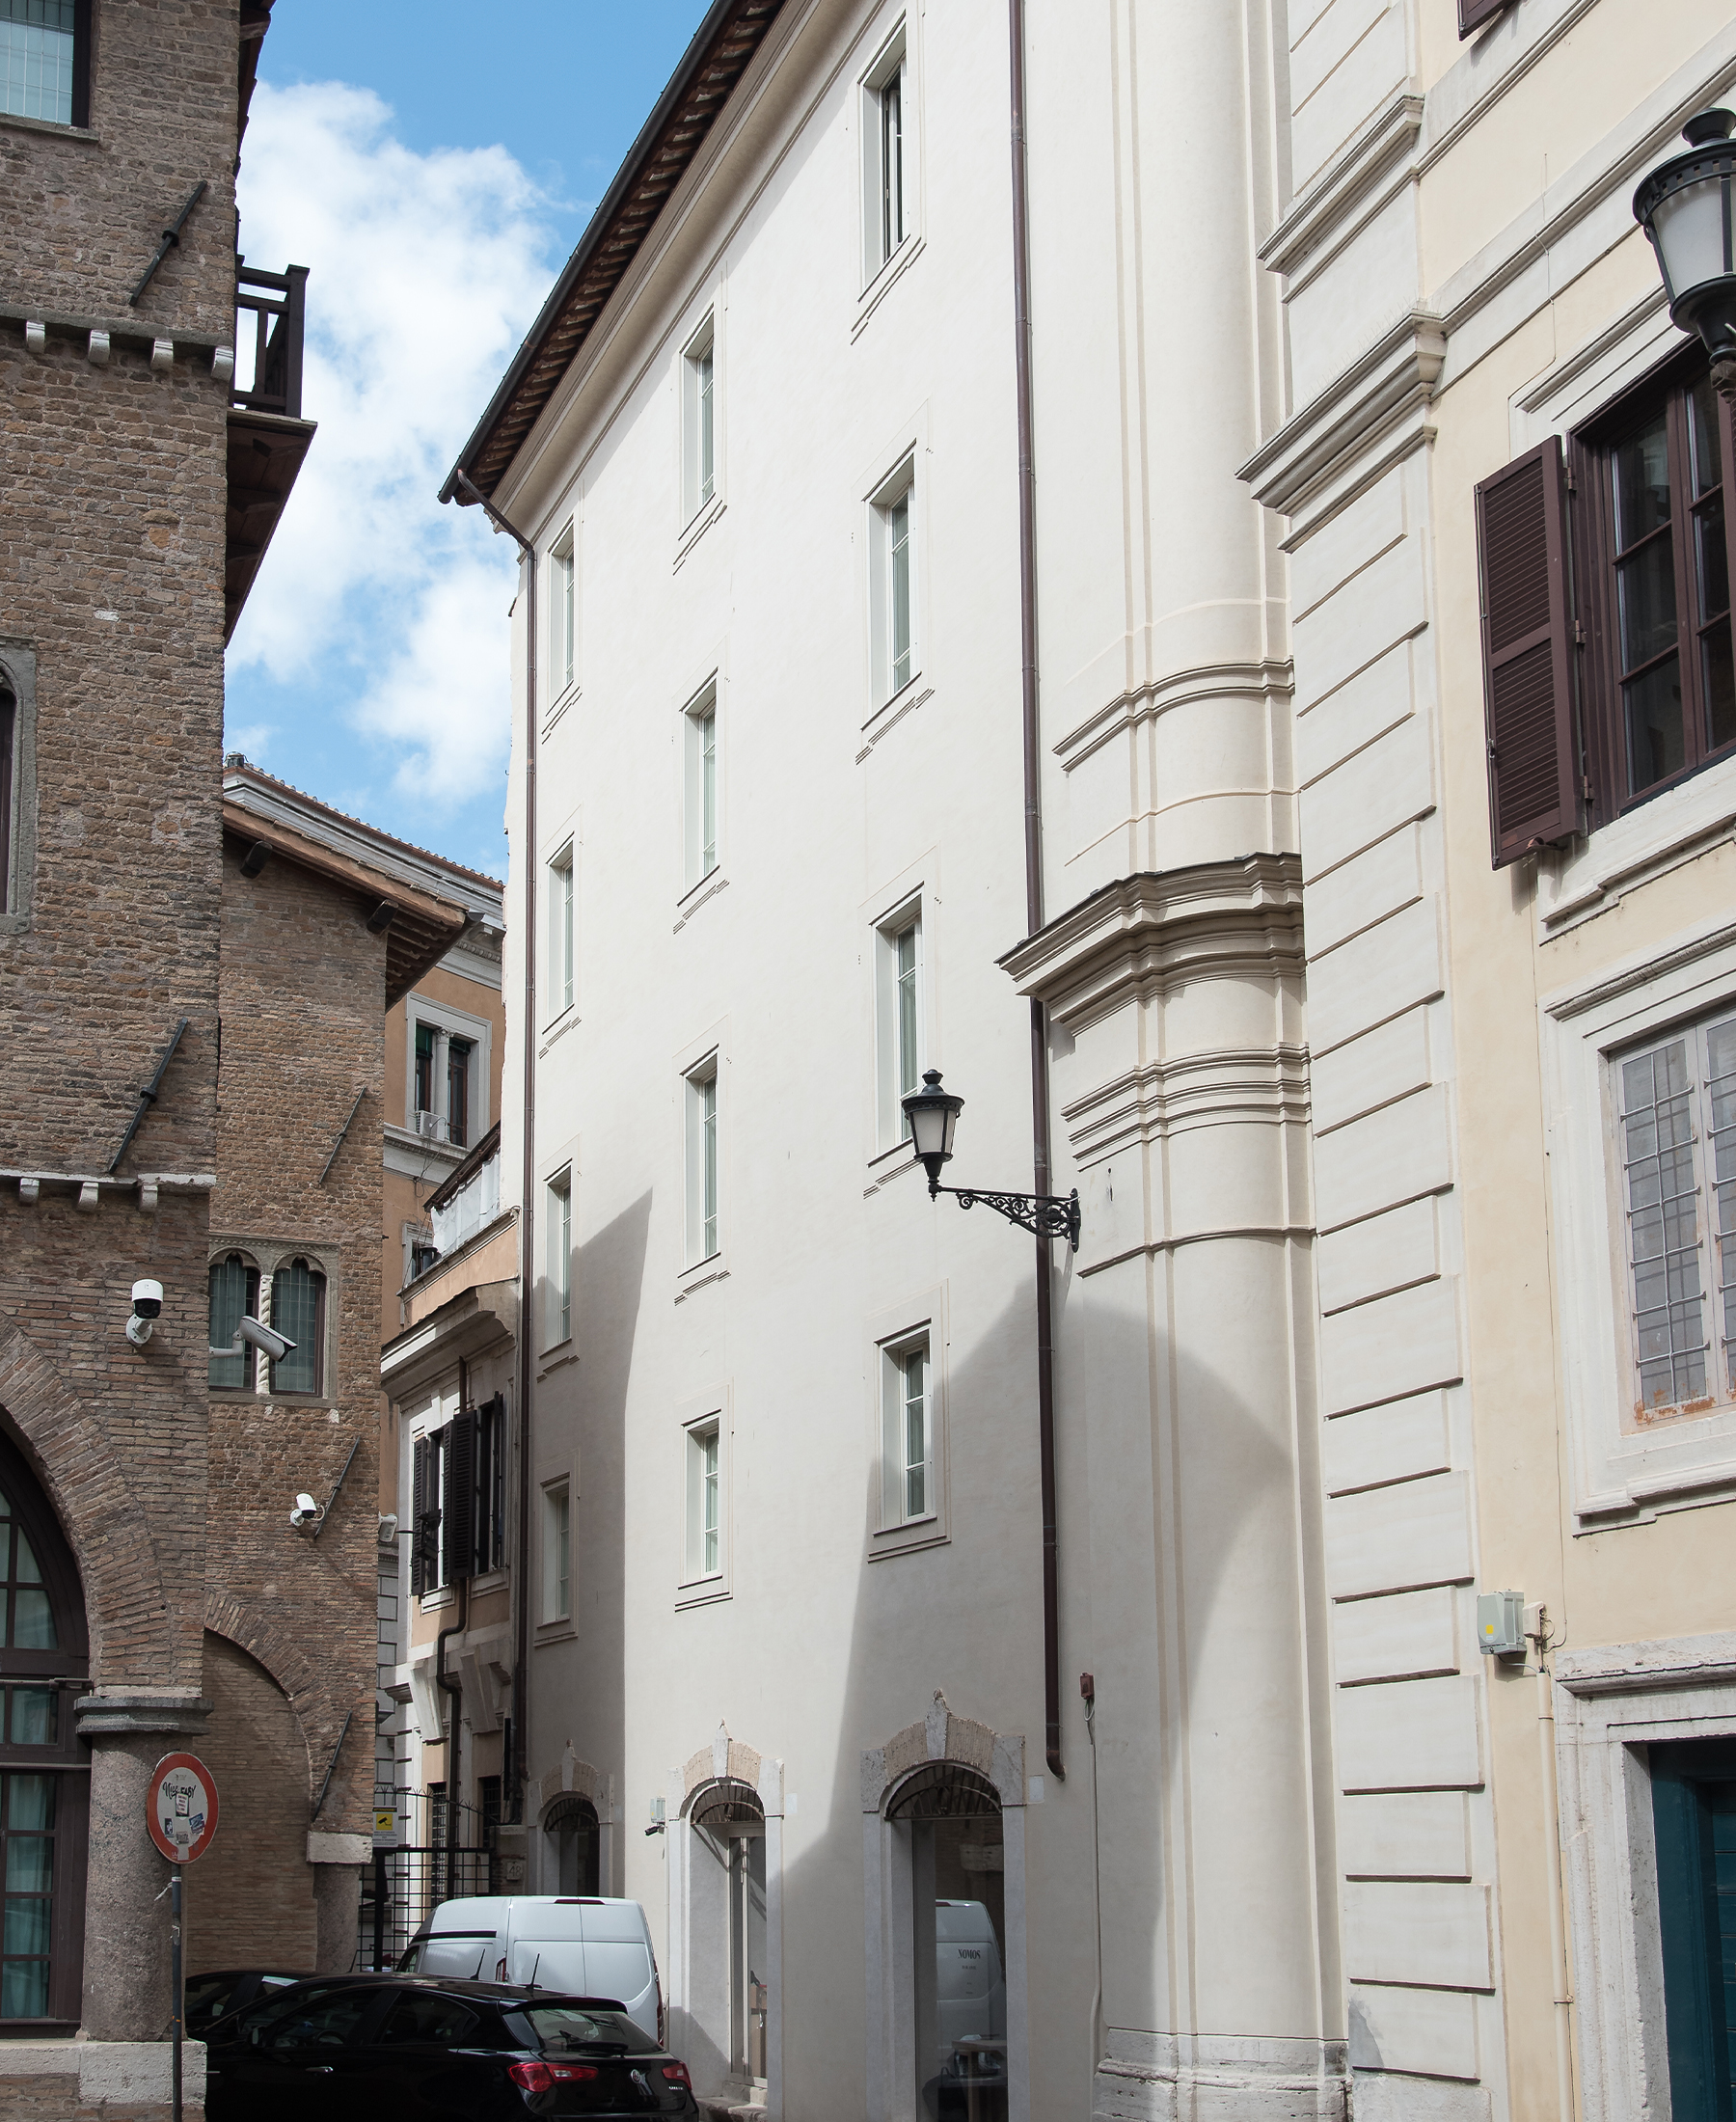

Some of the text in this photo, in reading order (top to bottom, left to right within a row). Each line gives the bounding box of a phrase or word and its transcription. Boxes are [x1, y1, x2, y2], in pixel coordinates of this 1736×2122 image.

[179, 1784, 197, 1799] EASY
[508, 1865, 522, 1877] 48
[958, 1948, 981, 1959] NOMOS
